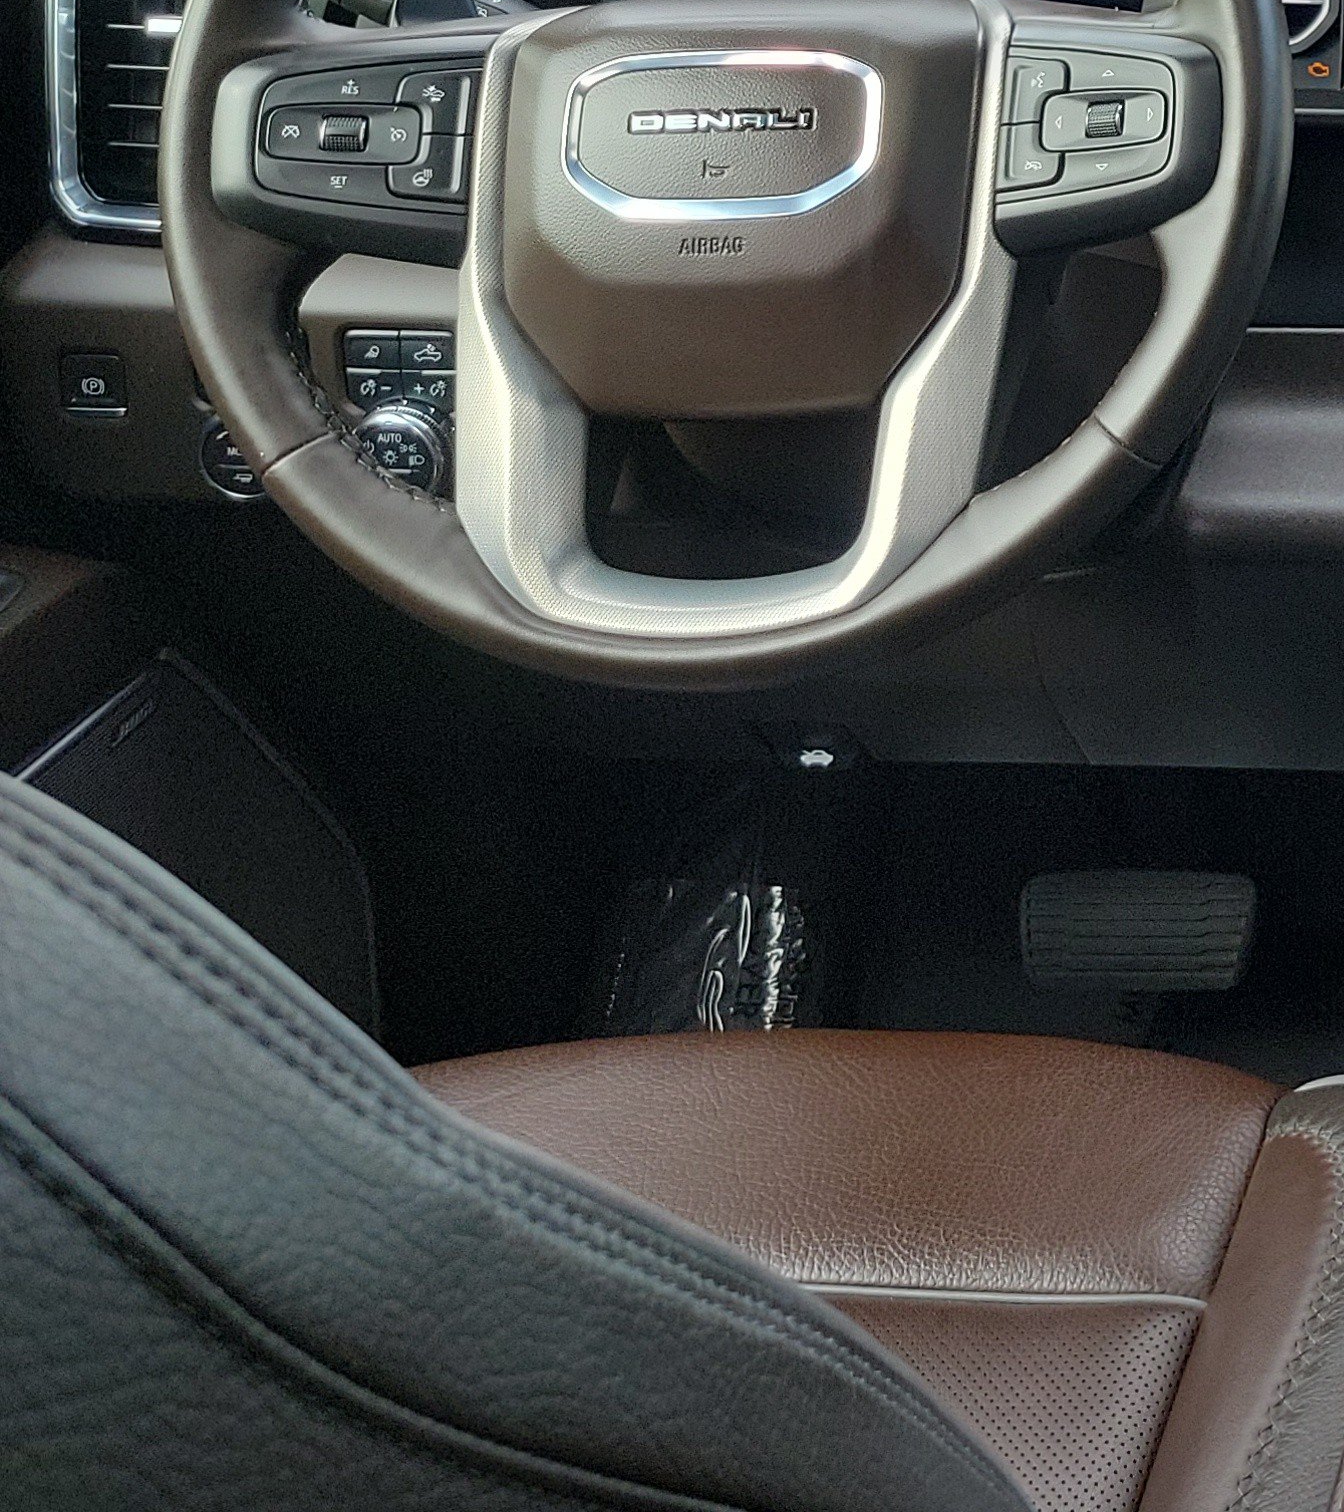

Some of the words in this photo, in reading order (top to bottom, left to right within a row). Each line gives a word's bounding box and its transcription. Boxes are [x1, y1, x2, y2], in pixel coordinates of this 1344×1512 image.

[341, 85, 359, 95] RES
[628, 108, 816, 135] DENALI
[330, 175, 348, 185] SET
[678, 237, 745, 255] AIRBAG
[377, 432, 403, 443] AUTO
